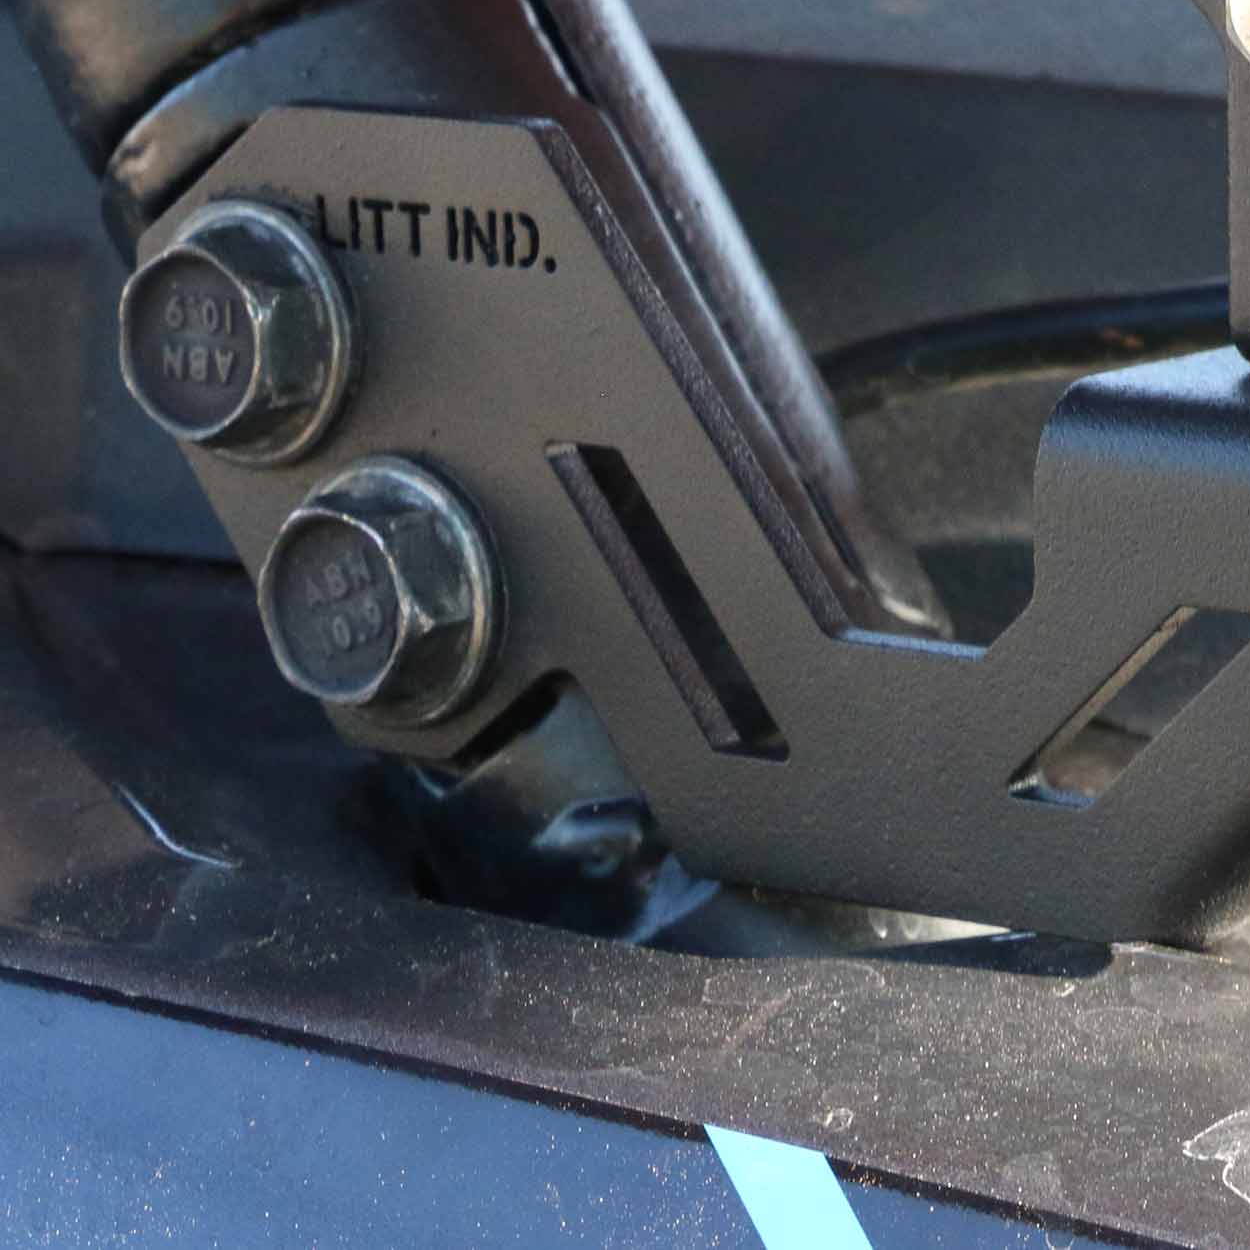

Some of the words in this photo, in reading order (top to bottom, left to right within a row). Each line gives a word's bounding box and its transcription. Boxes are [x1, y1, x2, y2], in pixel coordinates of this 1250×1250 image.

[314, 193, 431, 257] LITT
[446, 205, 557, 274] IND.
[161, 343, 235, 384] ABN
